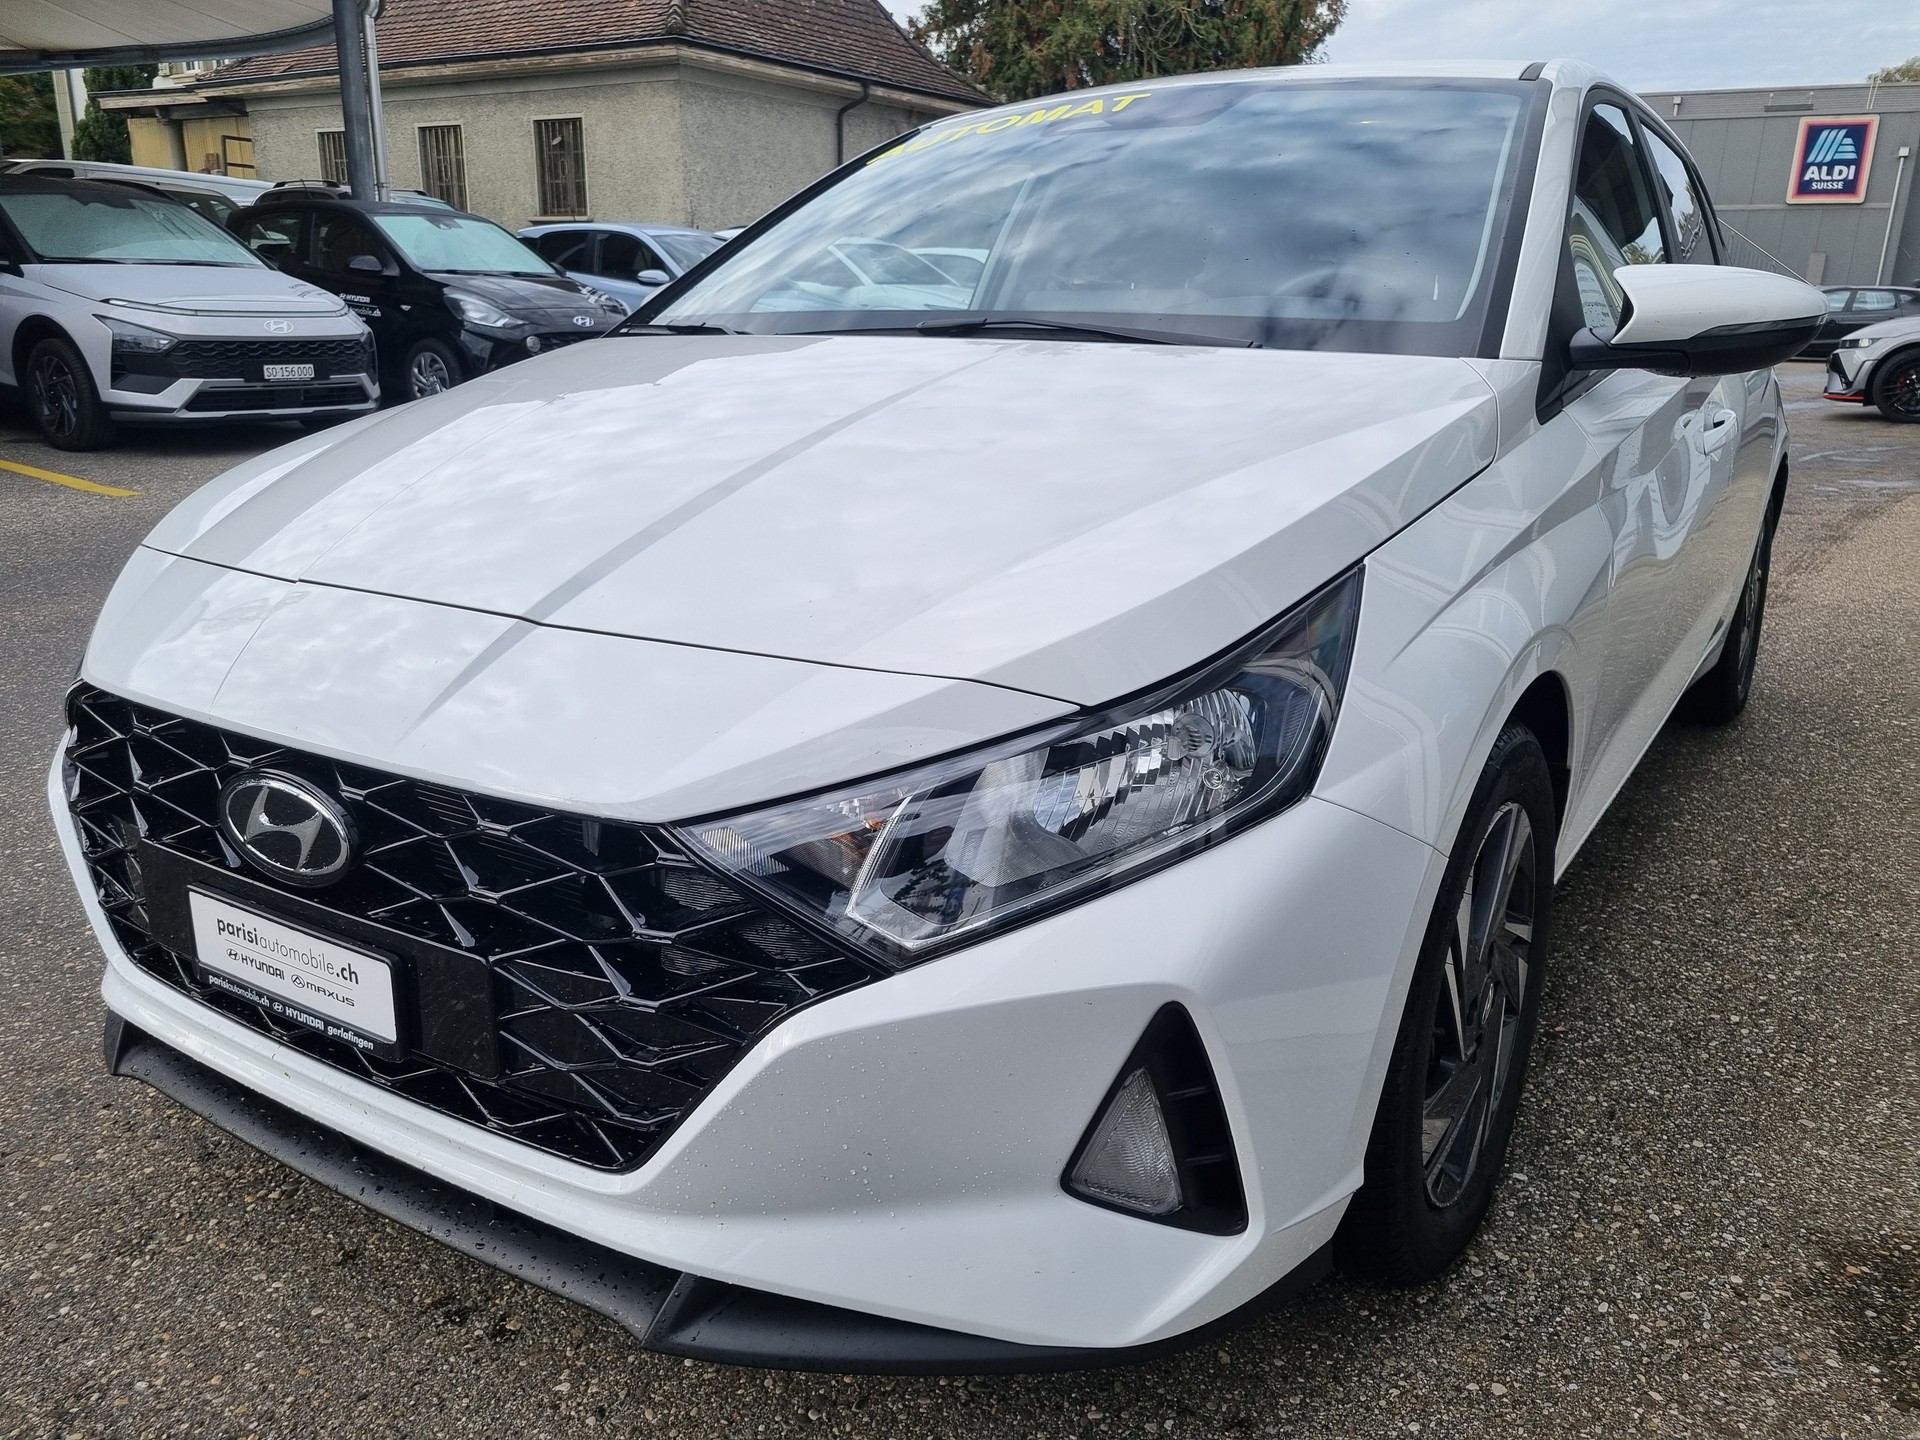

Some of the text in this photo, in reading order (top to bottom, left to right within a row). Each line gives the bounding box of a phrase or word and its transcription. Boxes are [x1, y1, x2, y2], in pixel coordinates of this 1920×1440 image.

[866, 94, 1152, 165] AUTOMAT
[1804, 165, 1856, 180] ALDI
[1811, 181, 1845, 190] SUISSE
[216, 917, 359, 985] parisiautomobile.ch
[241, 953, 355, 1007] HYUNDAI MAXUS
[208, 974, 374, 1051] parisiautomobile.ch HYUNDAI gerlafingen
